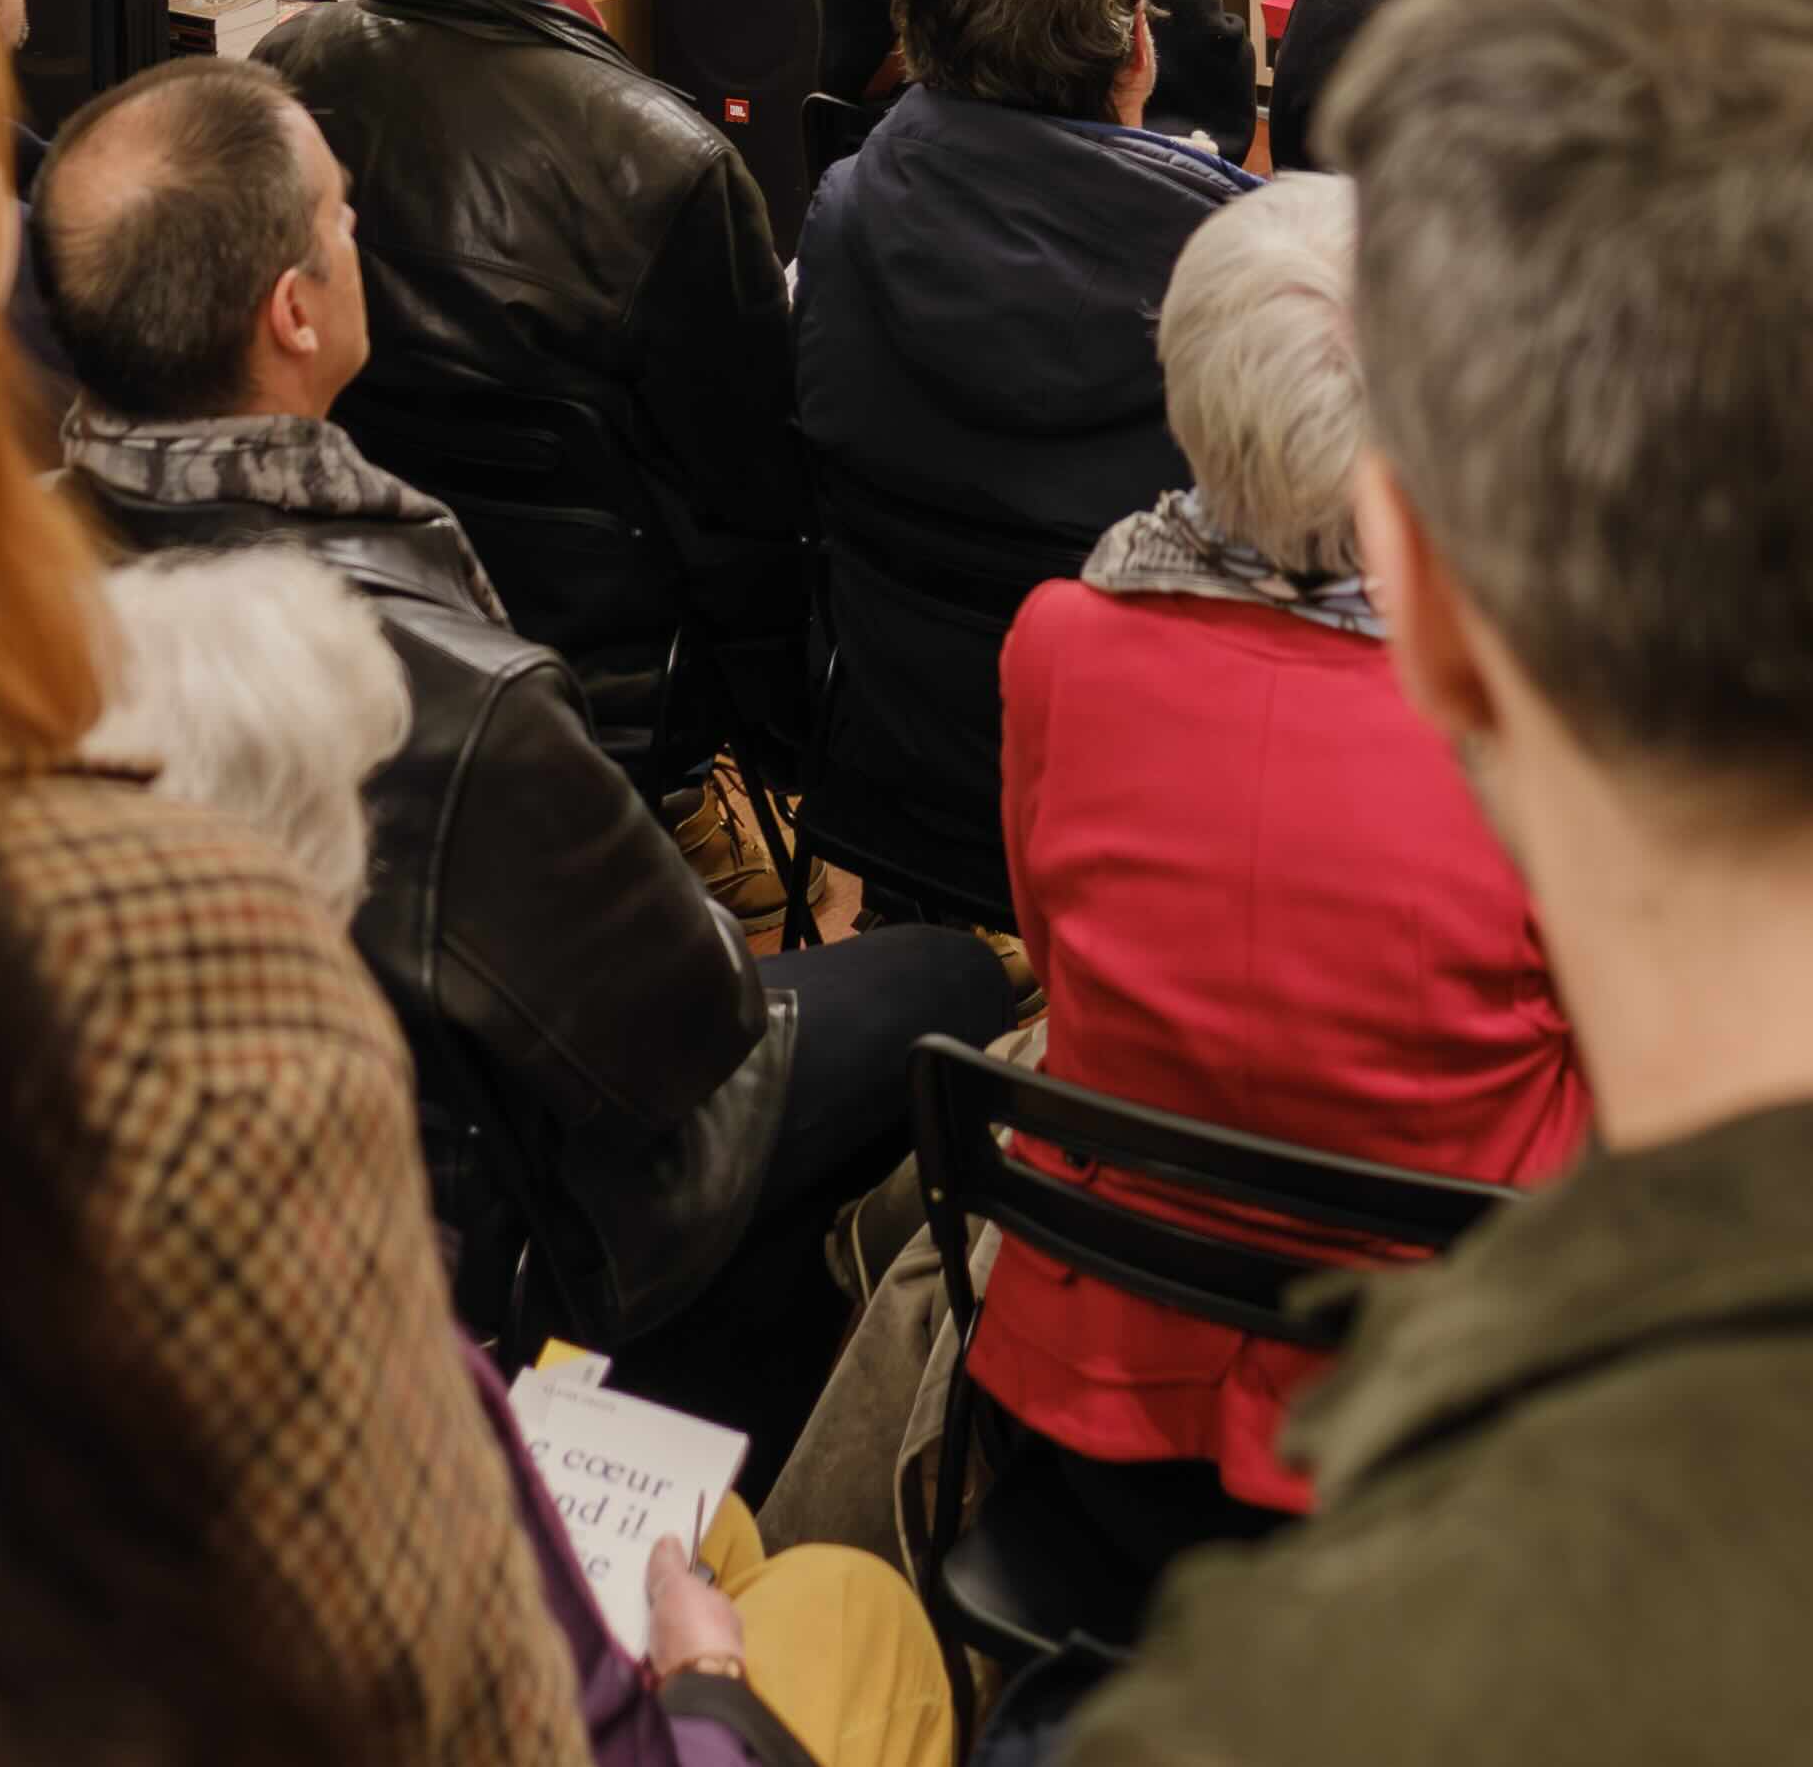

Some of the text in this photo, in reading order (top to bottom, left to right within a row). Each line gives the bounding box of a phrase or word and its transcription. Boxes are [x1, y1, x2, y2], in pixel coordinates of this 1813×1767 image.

[729, 104, 746, 118] JBL
[561, 1441, 675, 1501] cœur
[617, 1500, 650, 1542] il
